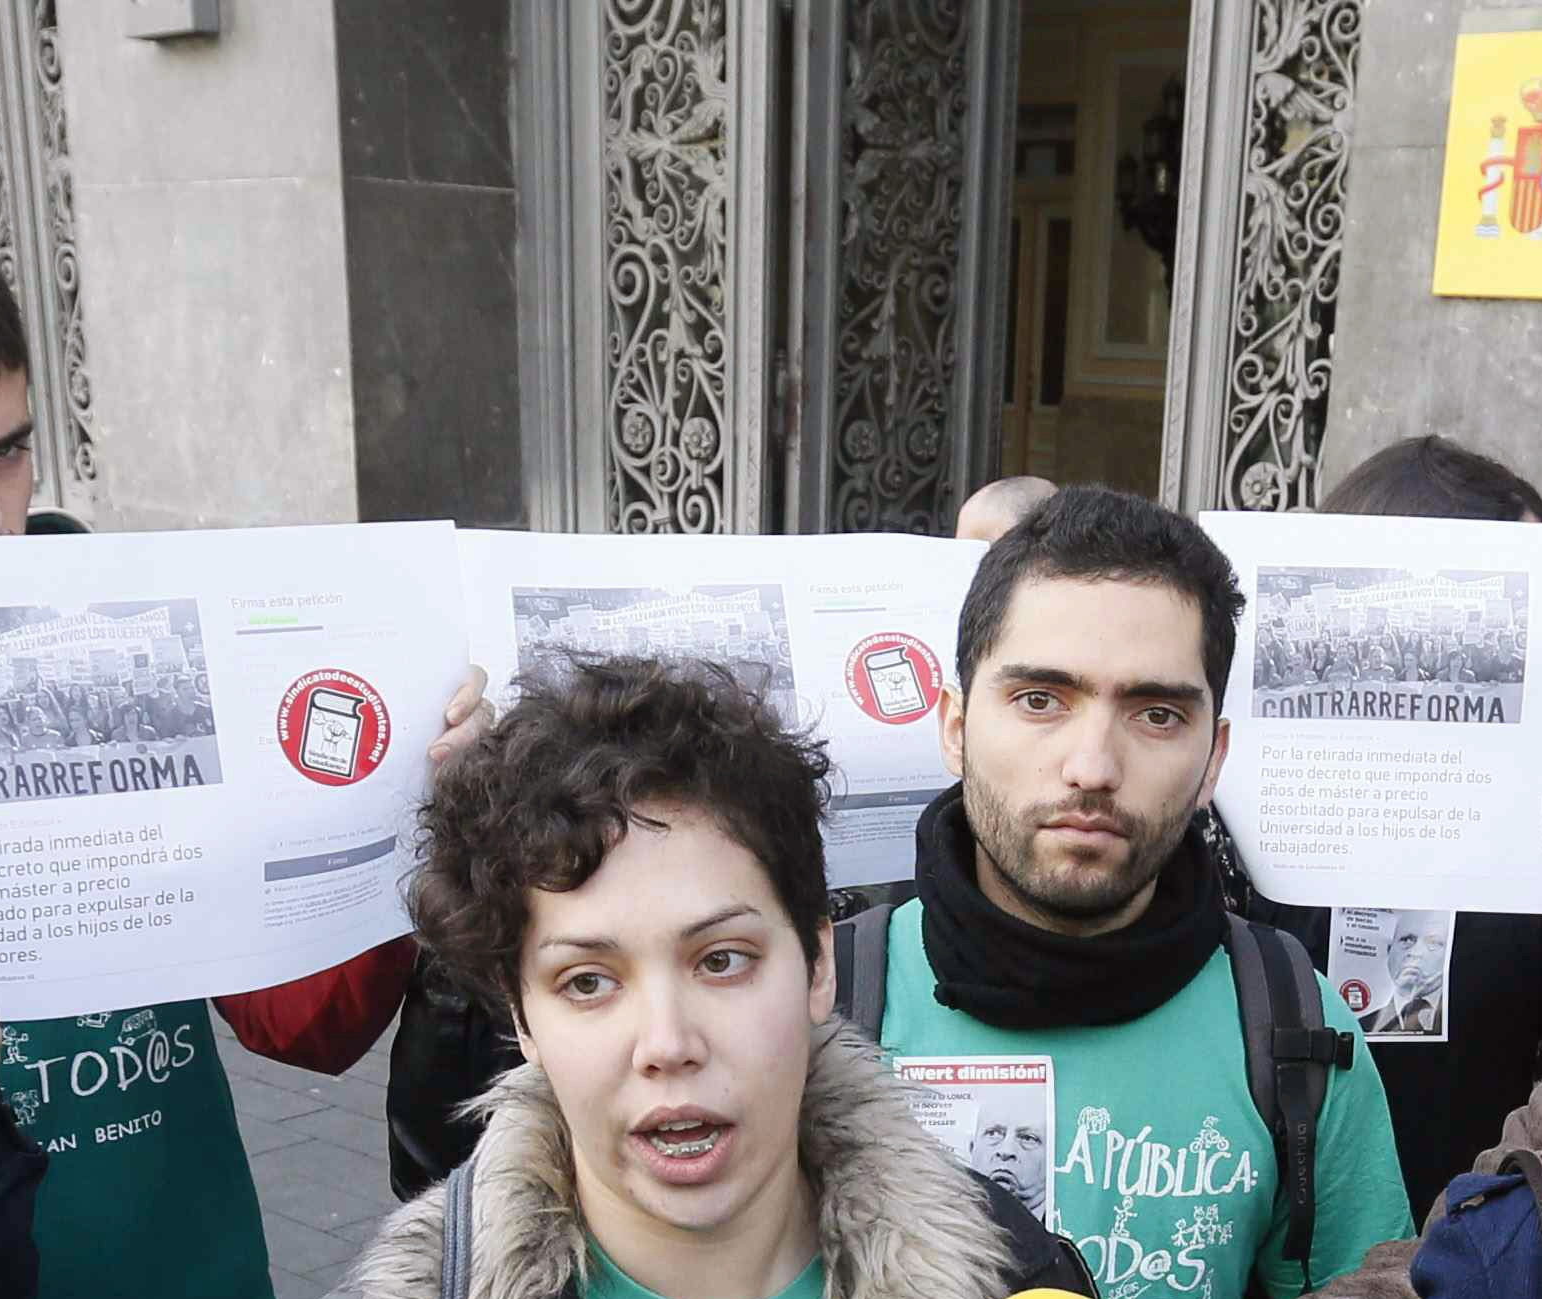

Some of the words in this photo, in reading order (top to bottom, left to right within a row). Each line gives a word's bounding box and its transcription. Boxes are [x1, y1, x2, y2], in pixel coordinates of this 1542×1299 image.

[1262, 691, 1505, 723] CONTRARREFORMA
[1262, 746, 1286, 760] Por
[1291, 746, 1303, 760] la
[1307, 746, 1363, 762] retirada
[1367, 749, 1436, 764] inmediata
[1441, 750, 1462, 764] del
[1261, 767, 1303, 779] nuevo
[1307, 764, 1361, 780] decreto
[1365, 770, 1390, 783] que
[1395, 768, 1462, 784] impondrá
[1466, 770, 1492, 784] dos
[1261, 784, 1294, 797] años
[1298, 784, 1314, 798] de
[1319, 784, 1370, 800] máster
[1374, 791, 1381, 800] a
[1385, 787, 1428, 801] precio
[1260, 801, 1344, 817] desorbitado
[1348, 807, 1379, 820] para
[1383, 806, 1443, 821] expulsar
[1447, 807, 1464, 821] de
[1468, 807, 1481, 821] la
[49, 828, 134, 850] inmediata
[139, 824, 163, 841] del
[1260, 820, 1342, 836] Universidad
[1346, 827, 1354, 836] a
[1359, 823, 1378, 837] los
[1383, 823, 1415, 840] hijos
[1419, 825, 1436, 839] de
[1440, 826, 1460, 840] los
[49, 857, 81, 876] que
[87, 848, 169, 871] impondrá
[173, 844, 203, 861] dos
[1259, 839, 1352, 856] trabajadores.
[62, 882, 72, 894] a
[77, 874, 130, 897] precio
[32, 902, 72, 921] para
[77, 891, 151, 916] expulsar
[155, 889, 176, 905] de
[180, 888, 194, 903] la
[32, 927, 42, 940] a
[47, 922, 73, 938] los
[78, 916, 119, 938] hijos
[124, 915, 144, 930] de
[148, 912, 172, 927] los
[25, 1023, 196, 1104] TOD@S
[958, 1064, 1046, 1080] dimisión!
[38, 1133, 77, 1153] AN
[95, 1110, 163, 1146] BENITO
[1103, 1125, 1259, 1200] PÚBLICA:
[1077, 1235, 1206, 1292] OD@S
